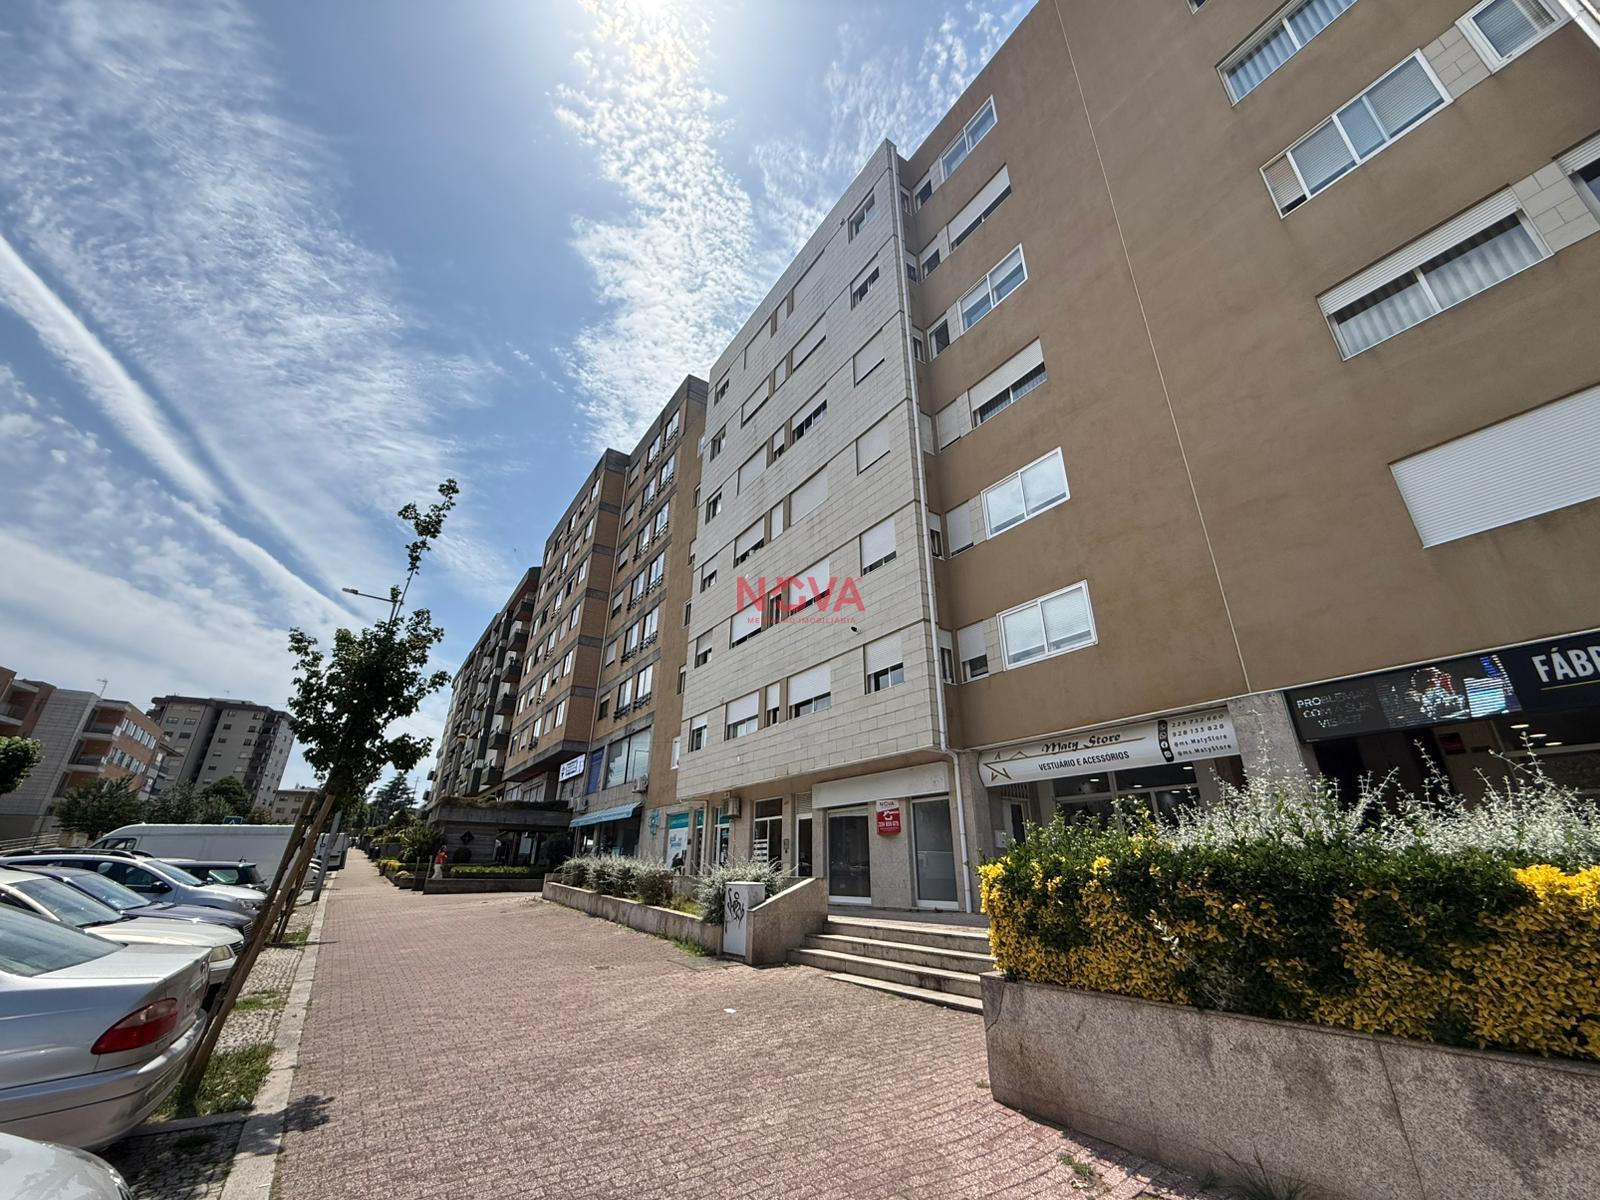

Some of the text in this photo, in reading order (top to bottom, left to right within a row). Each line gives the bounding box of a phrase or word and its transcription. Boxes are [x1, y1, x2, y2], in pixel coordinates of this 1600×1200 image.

[1041, 734, 1120, 755] Maty Store
[1038, 751, 1130, 771] VESTUÁRIO E ACESSÓRIOS
